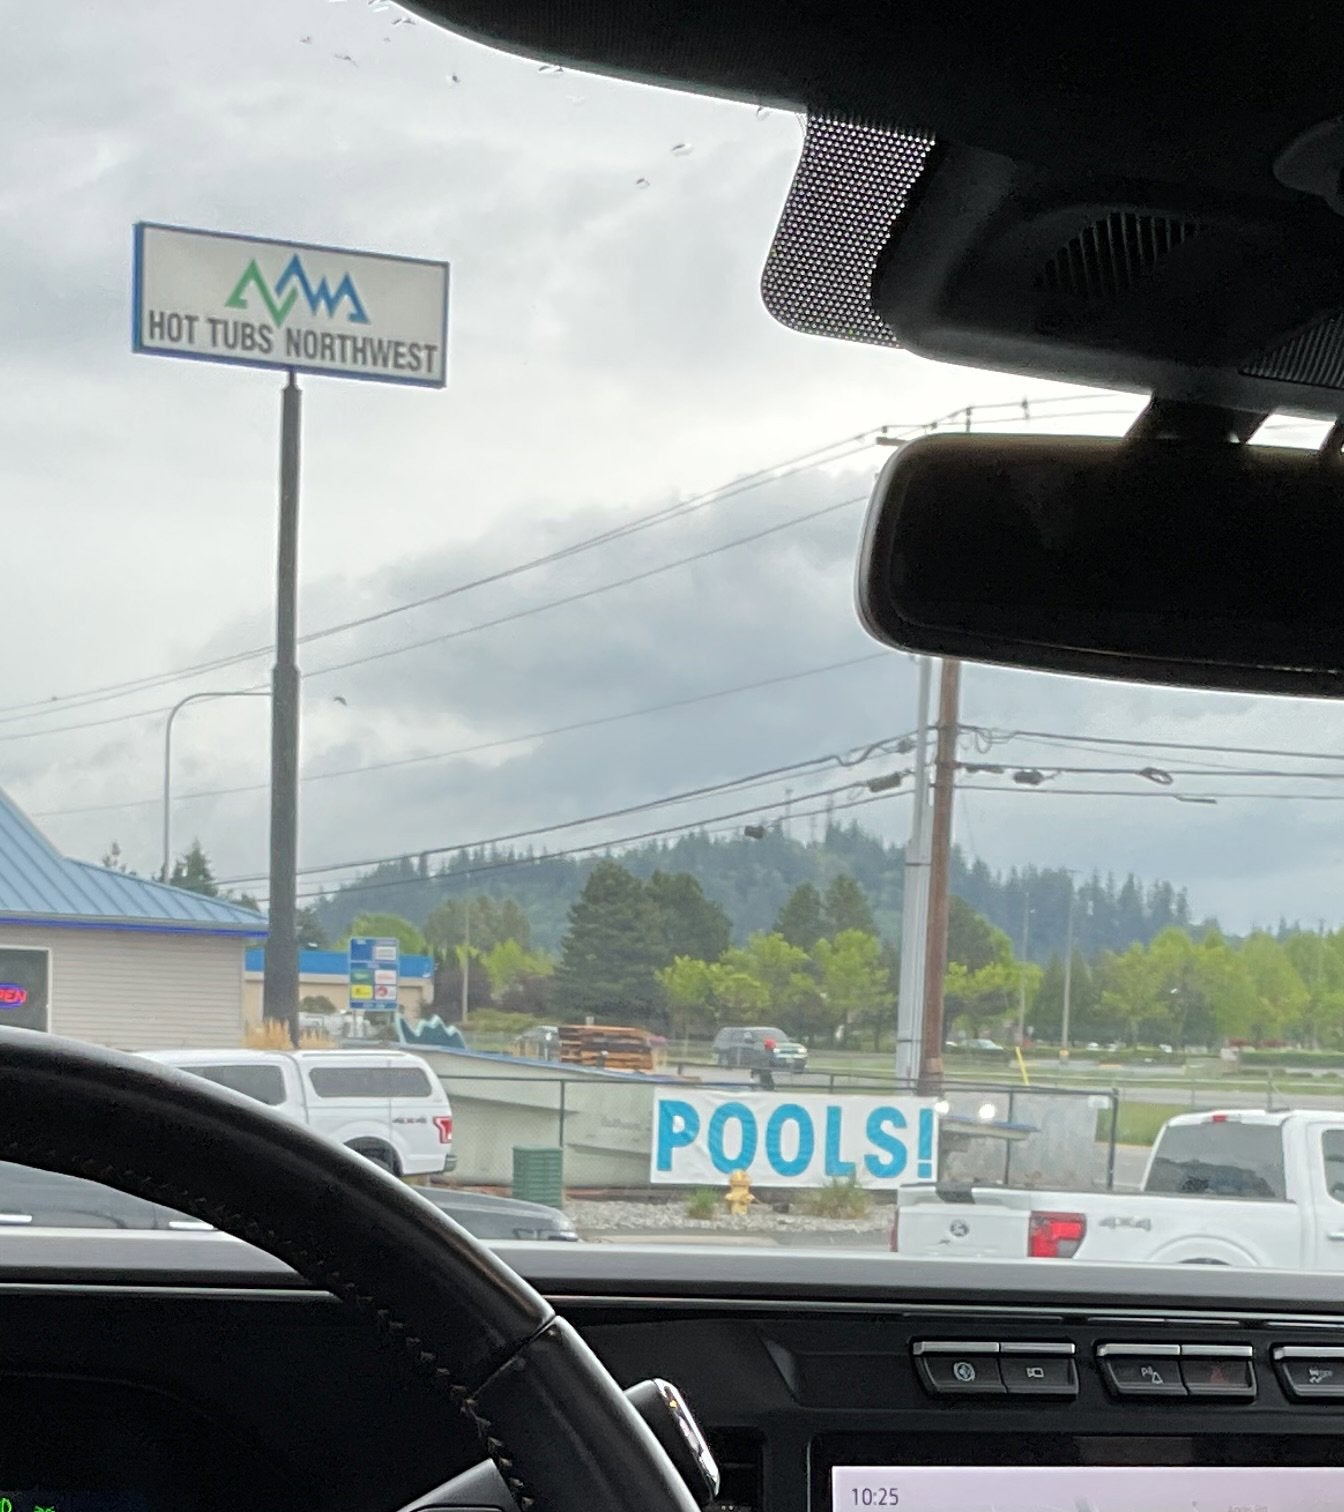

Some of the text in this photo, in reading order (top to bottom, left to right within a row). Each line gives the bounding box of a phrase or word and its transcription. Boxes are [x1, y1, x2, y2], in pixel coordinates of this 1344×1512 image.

[149, 310, 437, 373] HOT TUBS NORTHWEST
[656, 1099, 934, 1179] POOLS!
[851, 1487, 899, 1506] 10:25
